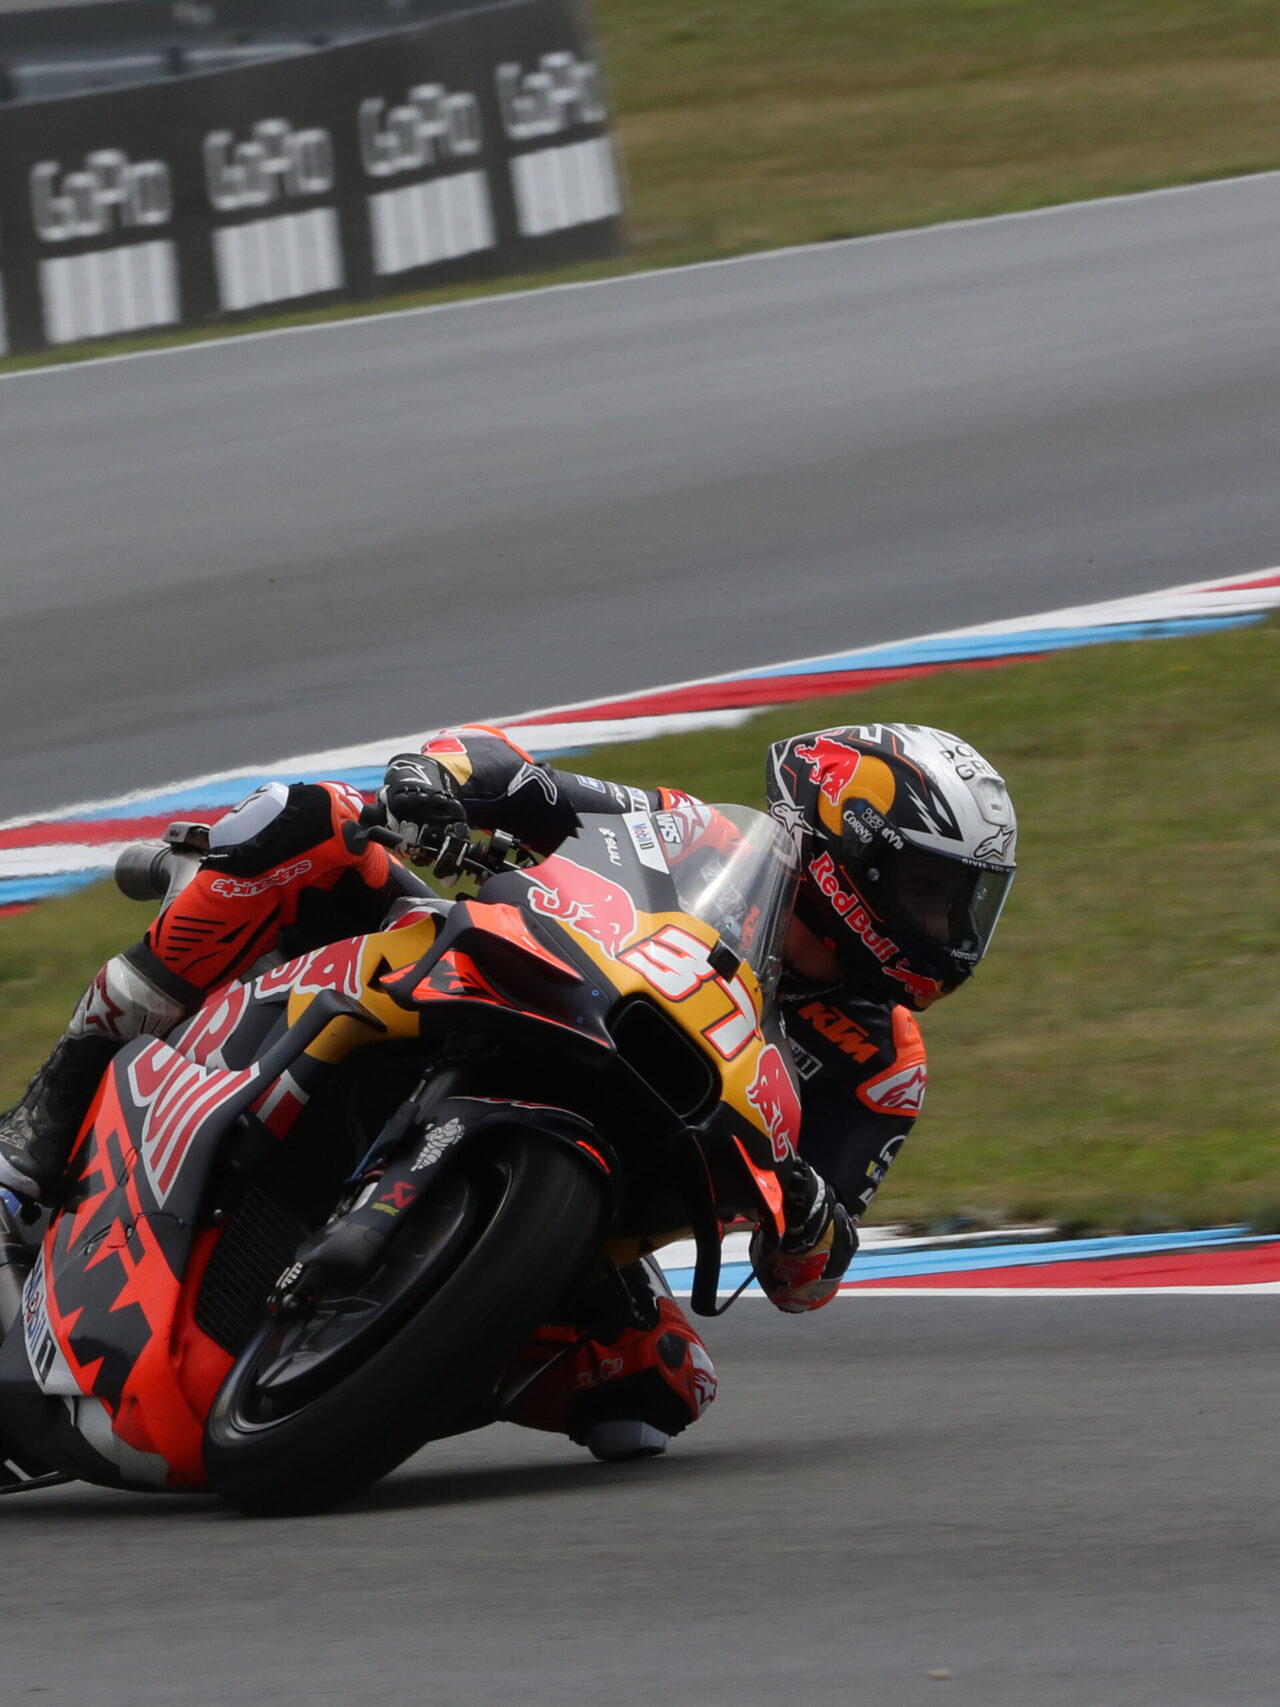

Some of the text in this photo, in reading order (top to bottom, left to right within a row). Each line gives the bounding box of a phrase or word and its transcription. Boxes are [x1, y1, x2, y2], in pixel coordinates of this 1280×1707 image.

[204, 118, 334, 210] GoPro
[358, 83, 481, 177] GoPro
[30, 149, 172, 242] GoPro
[632, 823, 651, 845] Mobil
[655, 813, 683, 844] WRS
[843, 810, 872, 841] CORNY
[211, 859, 312, 898] alpinestars
[809, 852, 858, 916] Red
[845, 905, 900, 962] Bull
[616, 924, 763, 1061] 37
[798, 1001, 879, 1063] KTM
